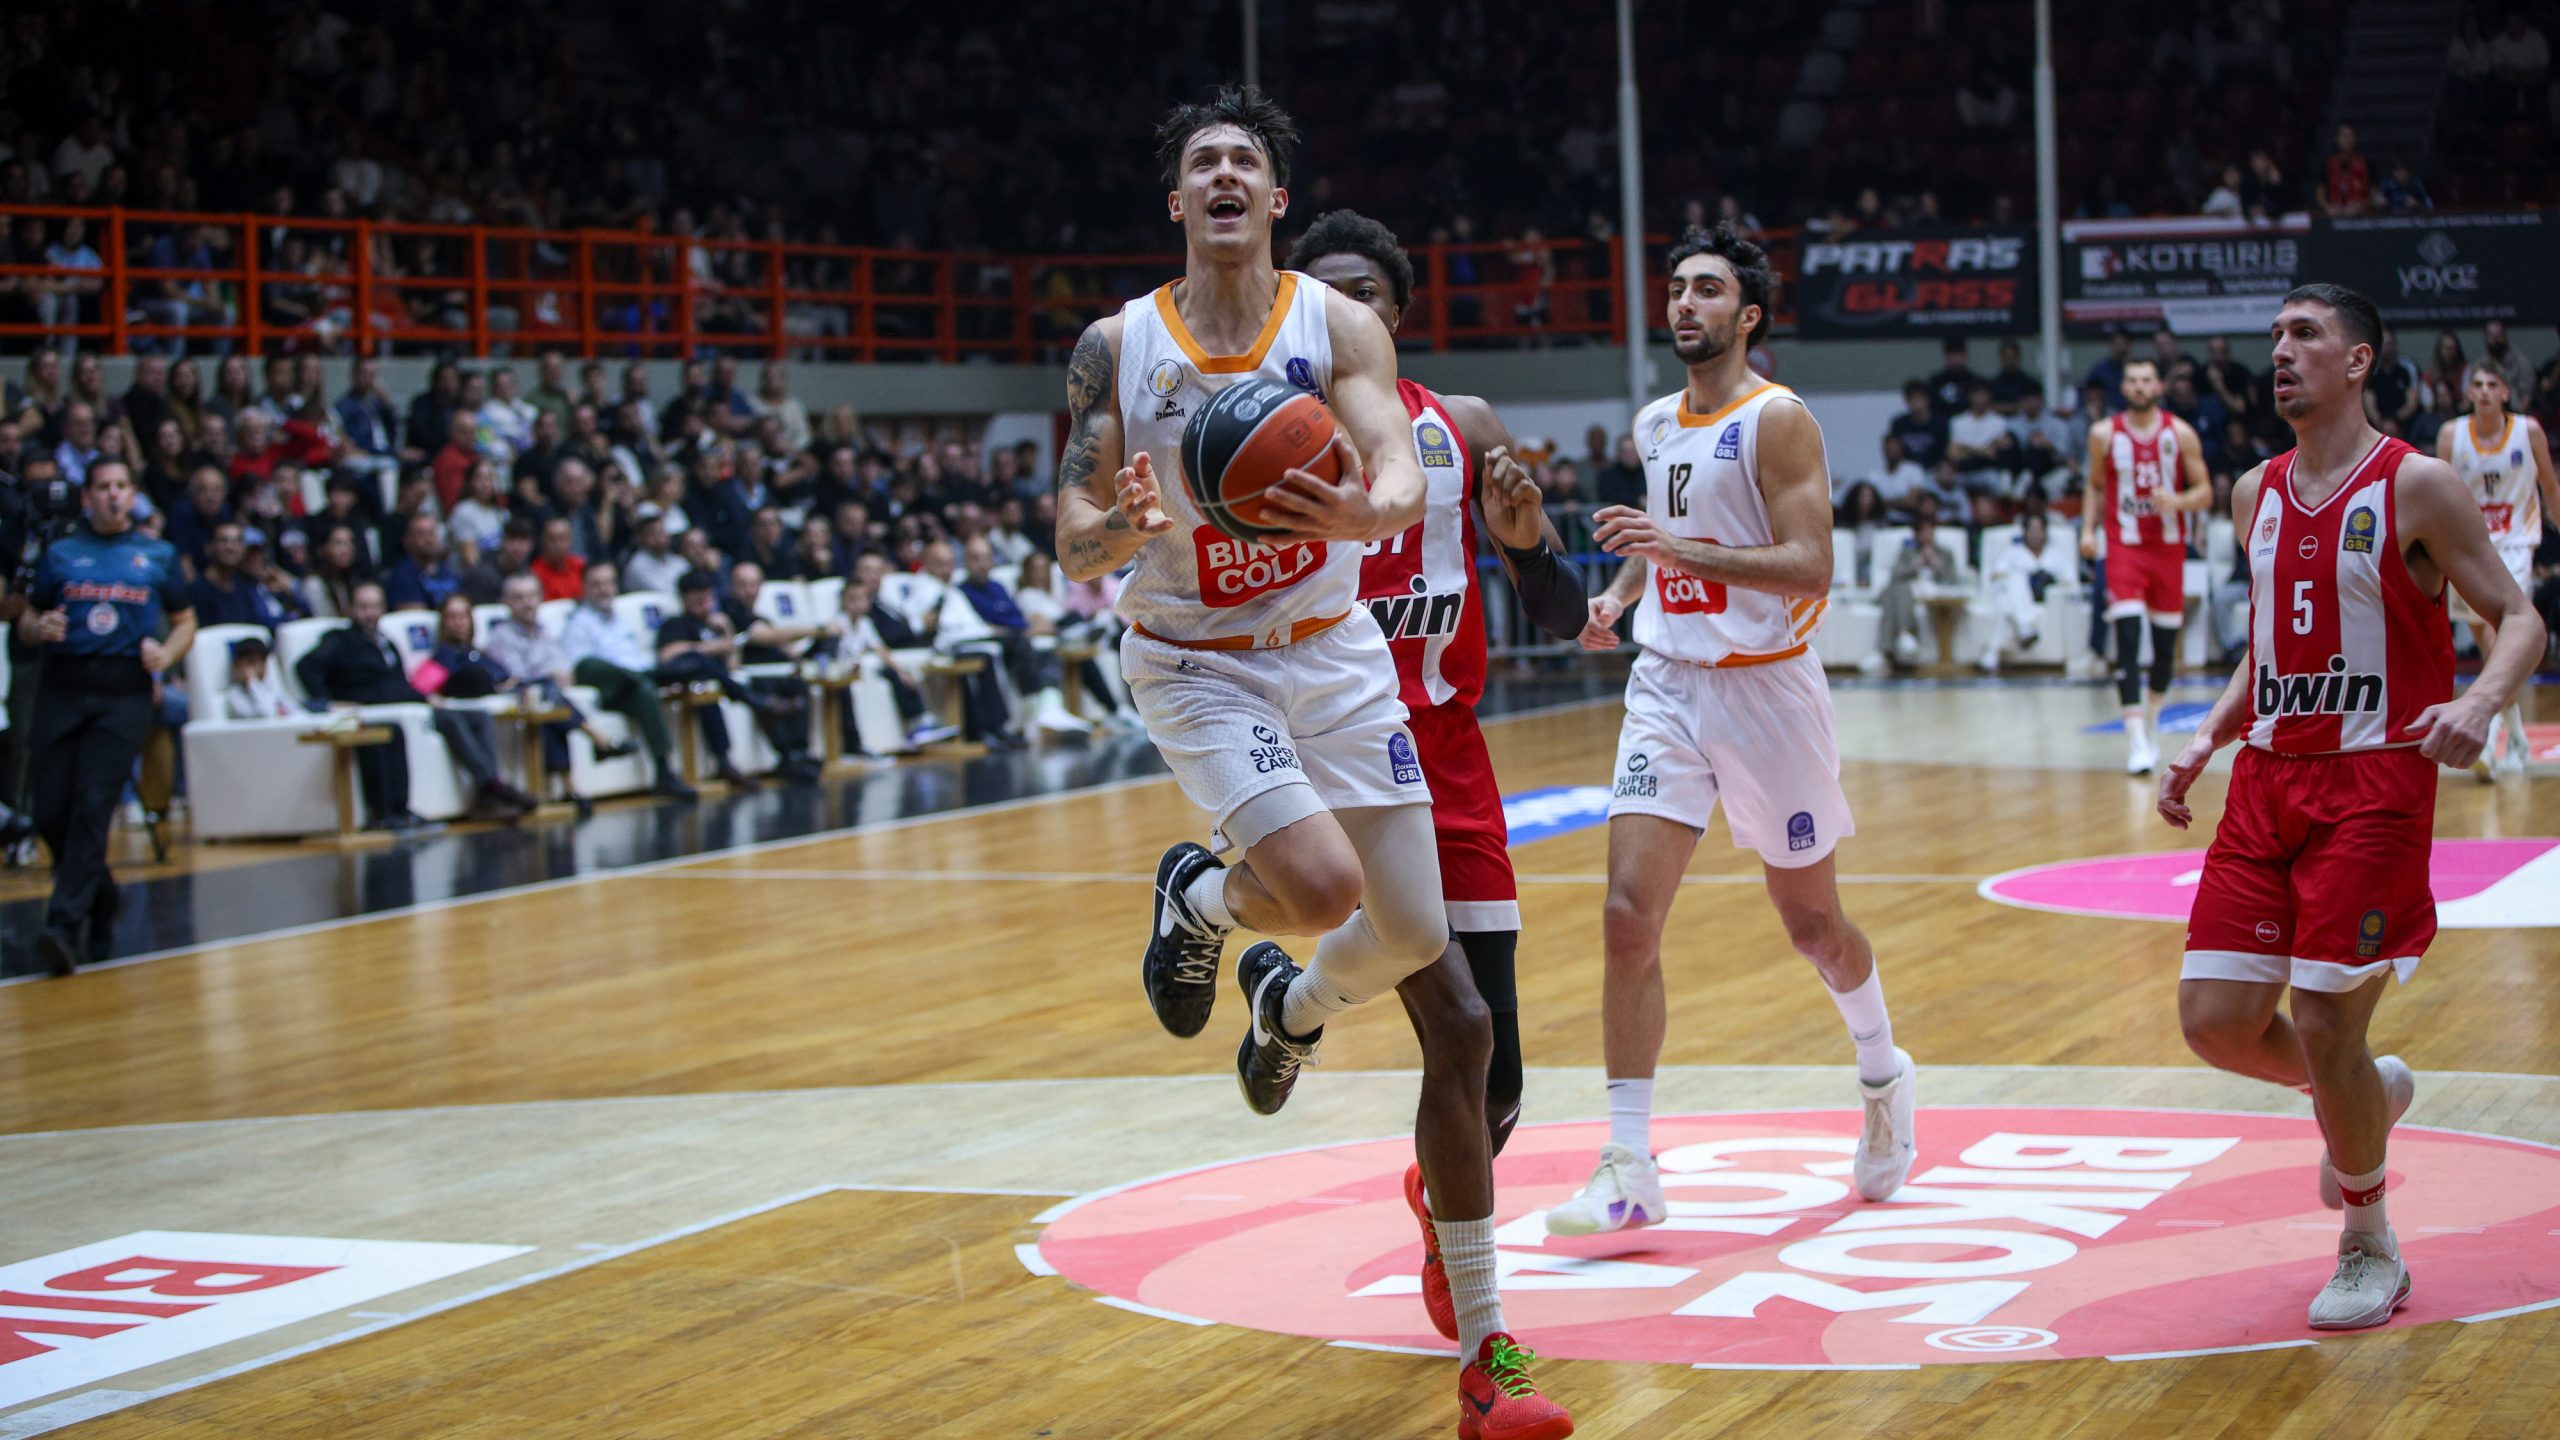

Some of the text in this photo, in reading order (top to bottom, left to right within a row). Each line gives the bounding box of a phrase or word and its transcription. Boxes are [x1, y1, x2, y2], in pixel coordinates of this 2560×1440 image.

[1802, 237, 2024, 275] PATRAS
[1843, 279, 2017, 312] GLASS
[1715, 448, 1737, 459] GBL
[1424, 455, 1452, 466] GBL
[1668, 463, 1692, 518] 12
[2344, 539, 2371, 552] GBL
[1217, 544, 1314, 594] COLA
[2292, 580, 2313, 636] 5
[2256, 654, 2386, 717] bwin
[1397, 769, 1420, 781] GBL
[1618, 774, 1657, 787] SUPER
[1614, 785, 1657, 798] CARGO
[1791, 838, 1815, 850] GBL
